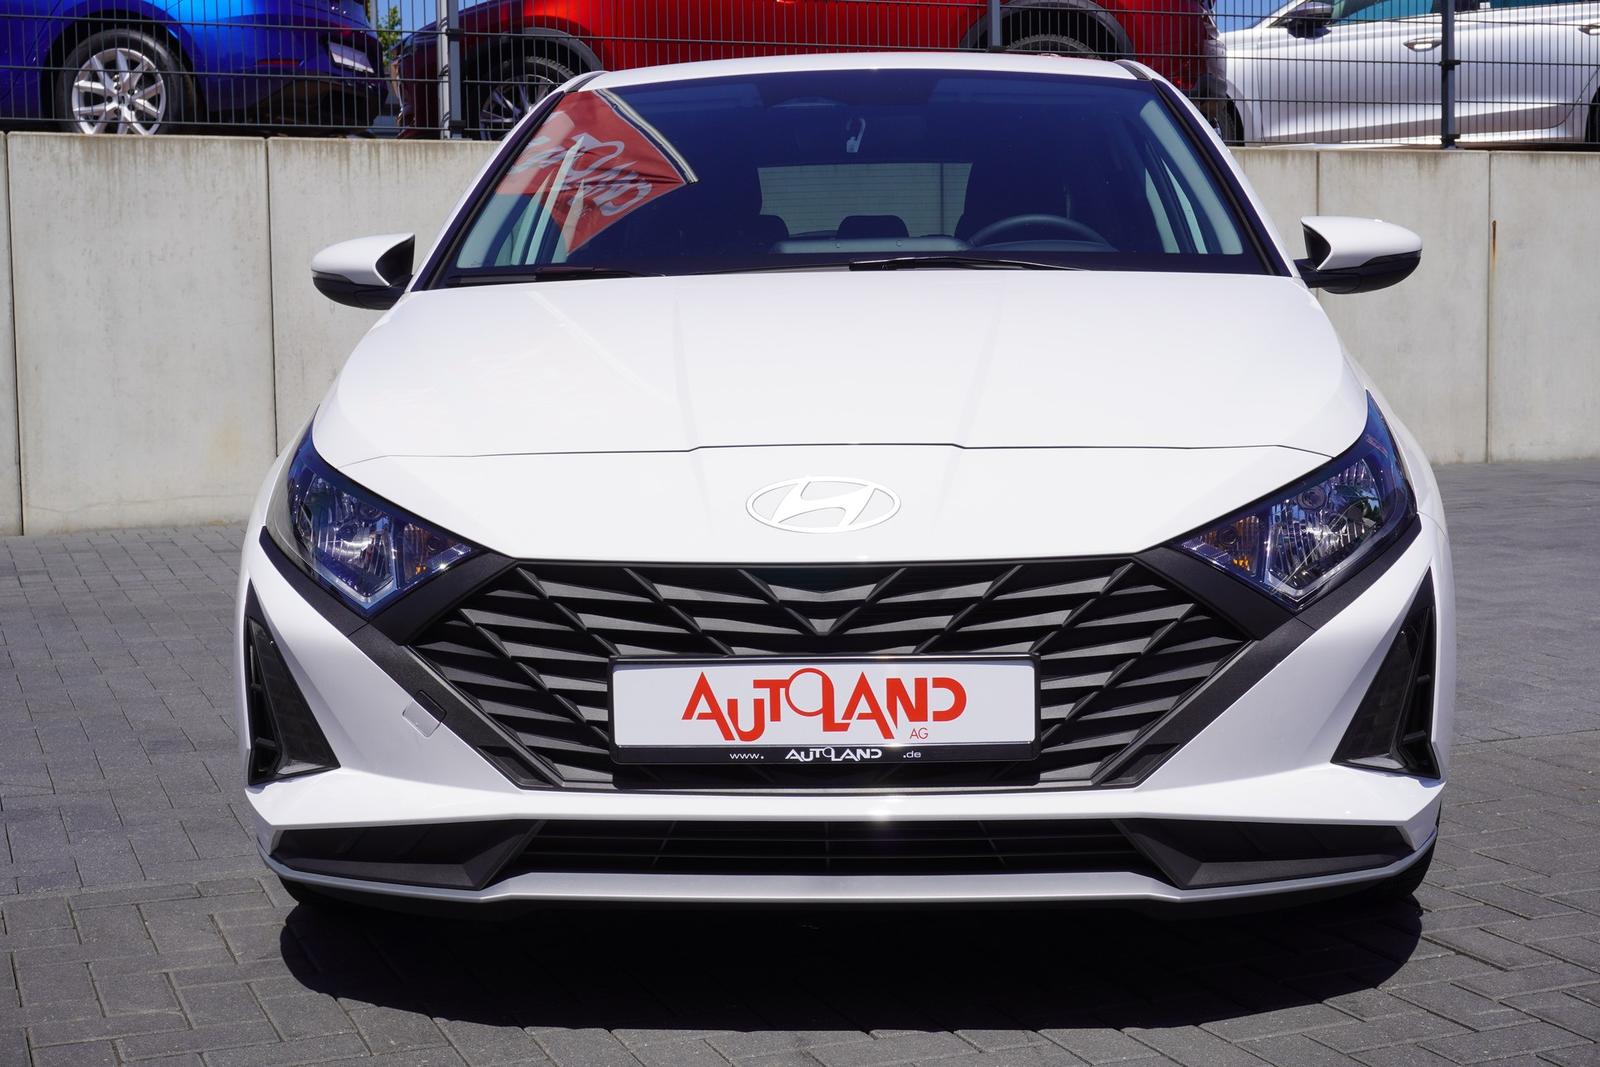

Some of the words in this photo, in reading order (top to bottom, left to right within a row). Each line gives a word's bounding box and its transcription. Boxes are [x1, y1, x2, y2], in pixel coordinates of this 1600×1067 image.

[909, 727, 930, 741] AG
[729, 752, 765, 761] www.
[902, 750, 922, 760] .de
